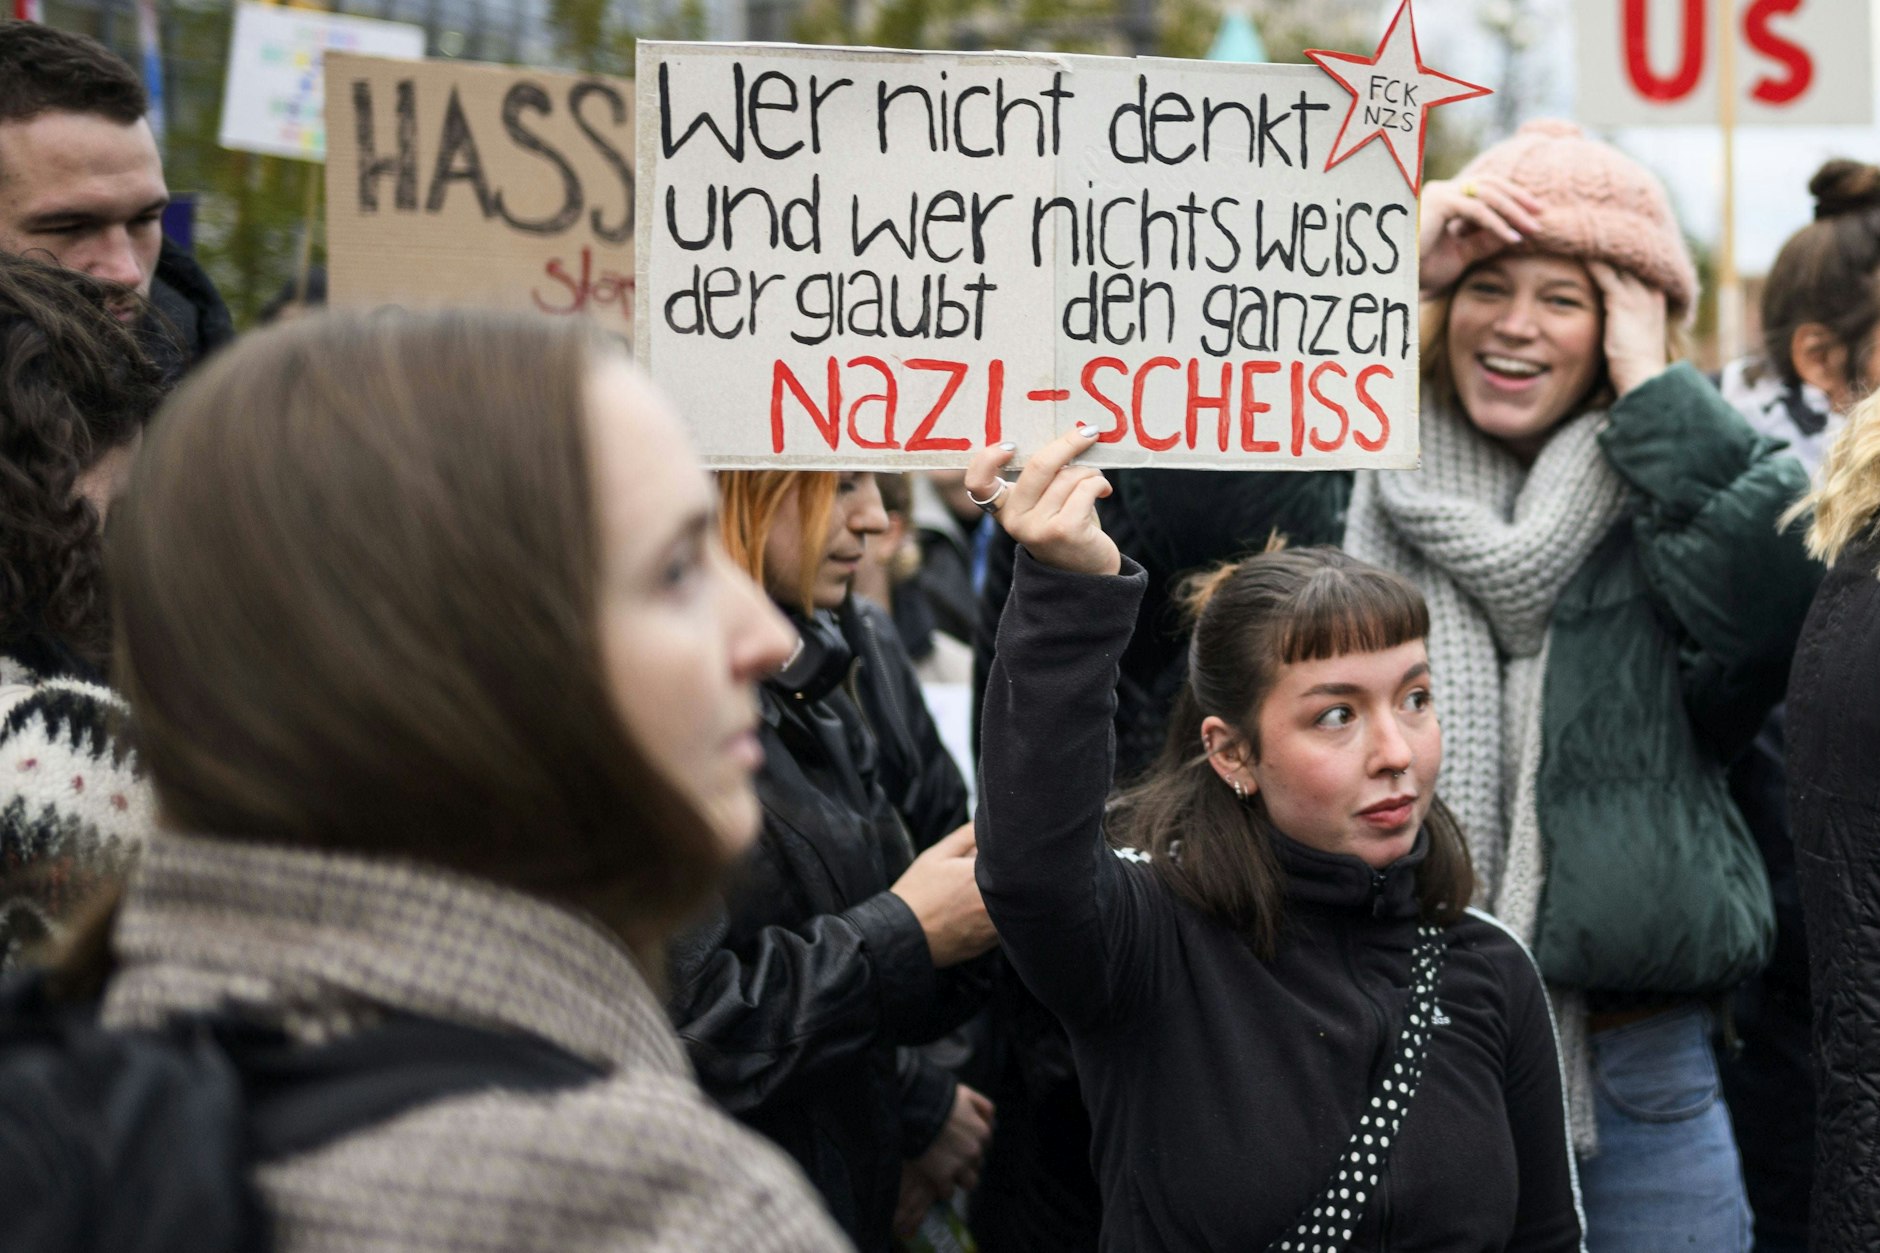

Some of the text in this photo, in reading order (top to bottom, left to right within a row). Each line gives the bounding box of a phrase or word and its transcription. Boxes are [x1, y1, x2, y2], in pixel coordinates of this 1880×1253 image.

[658, 61, 1331, 170] Wer nicht denkt
[1364, 105, 1415, 132] NZS
[1370, 75, 1418, 107] FCK
[351, 78, 636, 243] HASS
[665, 173, 1409, 277] und wer nichts weiss
[664, 264, 1410, 360] der glaubt den ganzen
